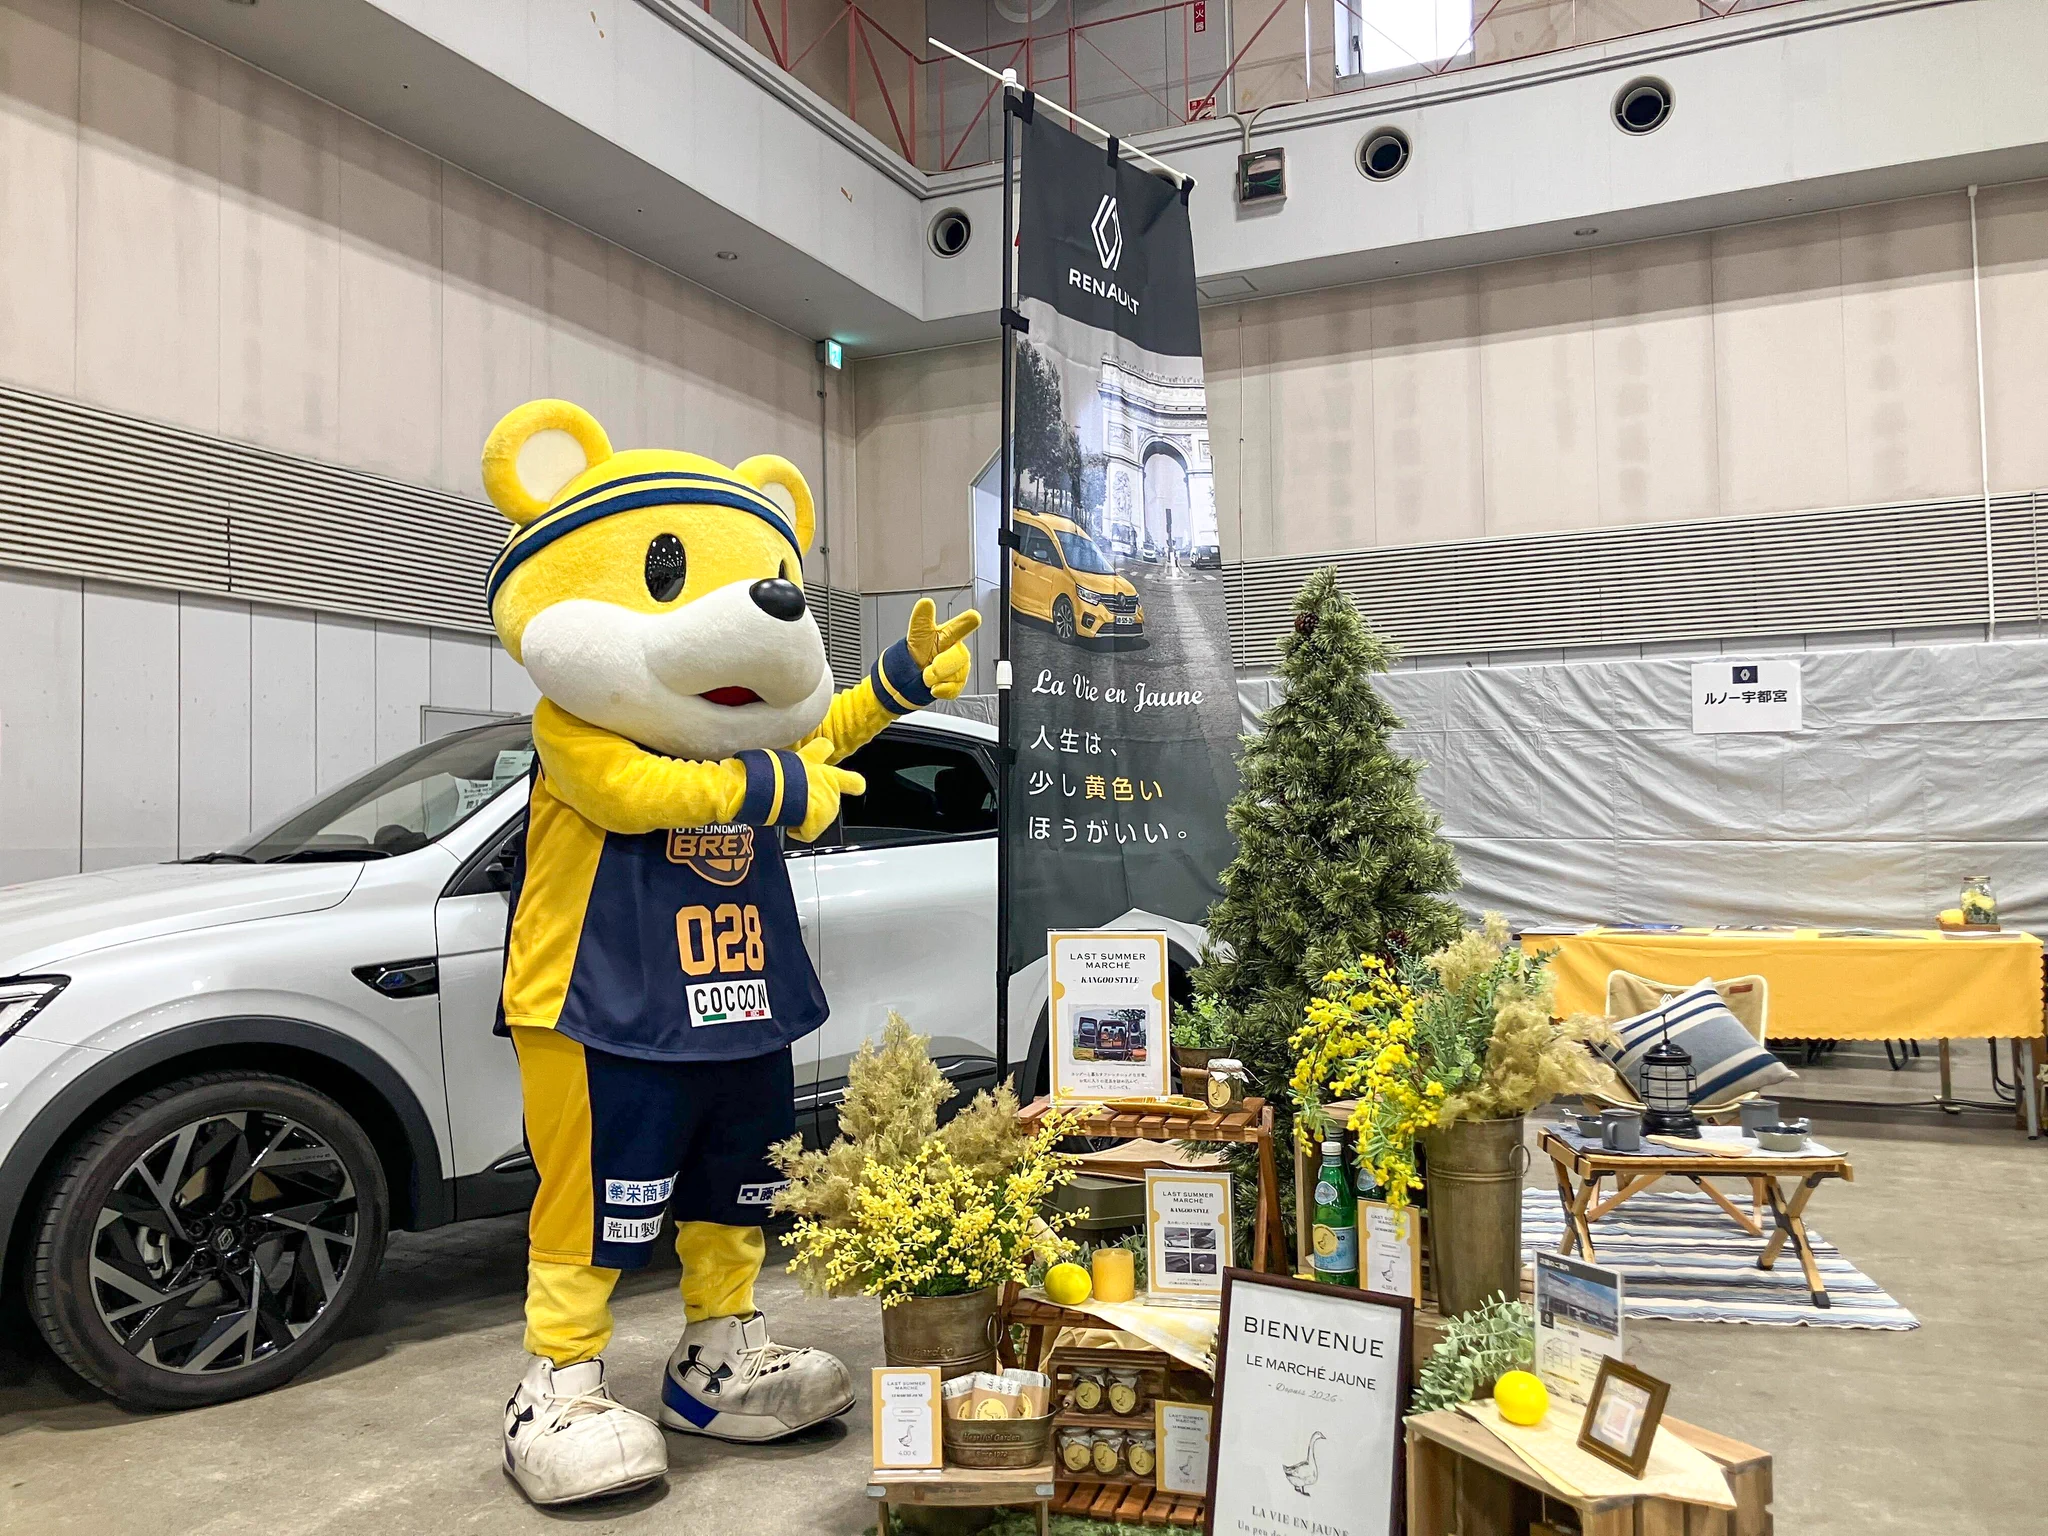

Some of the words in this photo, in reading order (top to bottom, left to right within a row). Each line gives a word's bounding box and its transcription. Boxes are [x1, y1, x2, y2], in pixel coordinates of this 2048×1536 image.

[1069, 268, 1139, 315] RENAULT
[1032, 669, 1066, 696] La
[1072, 673, 1099, 701] Vie
[1104, 687, 1127, 704] en
[1133, 682, 1204, 713] Jaune
[1704, 690, 1788, 705] ルノー宇都宮
[1030, 725, 1118, 757] 人生は、
[1028, 770, 1163, 802] 少し黄色い
[1028, 816, 1187, 844] ほうがいい。
[673, 834, 751, 857] BREX
[676, 904, 764, 976] 028
[1114, 976, 1140, 984] STYLE
[694, 984, 767, 1014] COCOON
[1244, 1316, 1384, 1358] BIENVENUE
[1246, 1353, 1262, 1368] LE
[1266, 1358, 1326, 1381] MARCHÉ
[1329, 1371, 1376, 1391] JAUNE
[1308, 1390, 1338, 1403] 2026
[1237, 1519, 1250, 1531] Un
[1252, 1505, 1266, 1518] LA
[1270, 1510, 1290, 1525] VIE
[1293, 1517, 1308, 1530] EN
